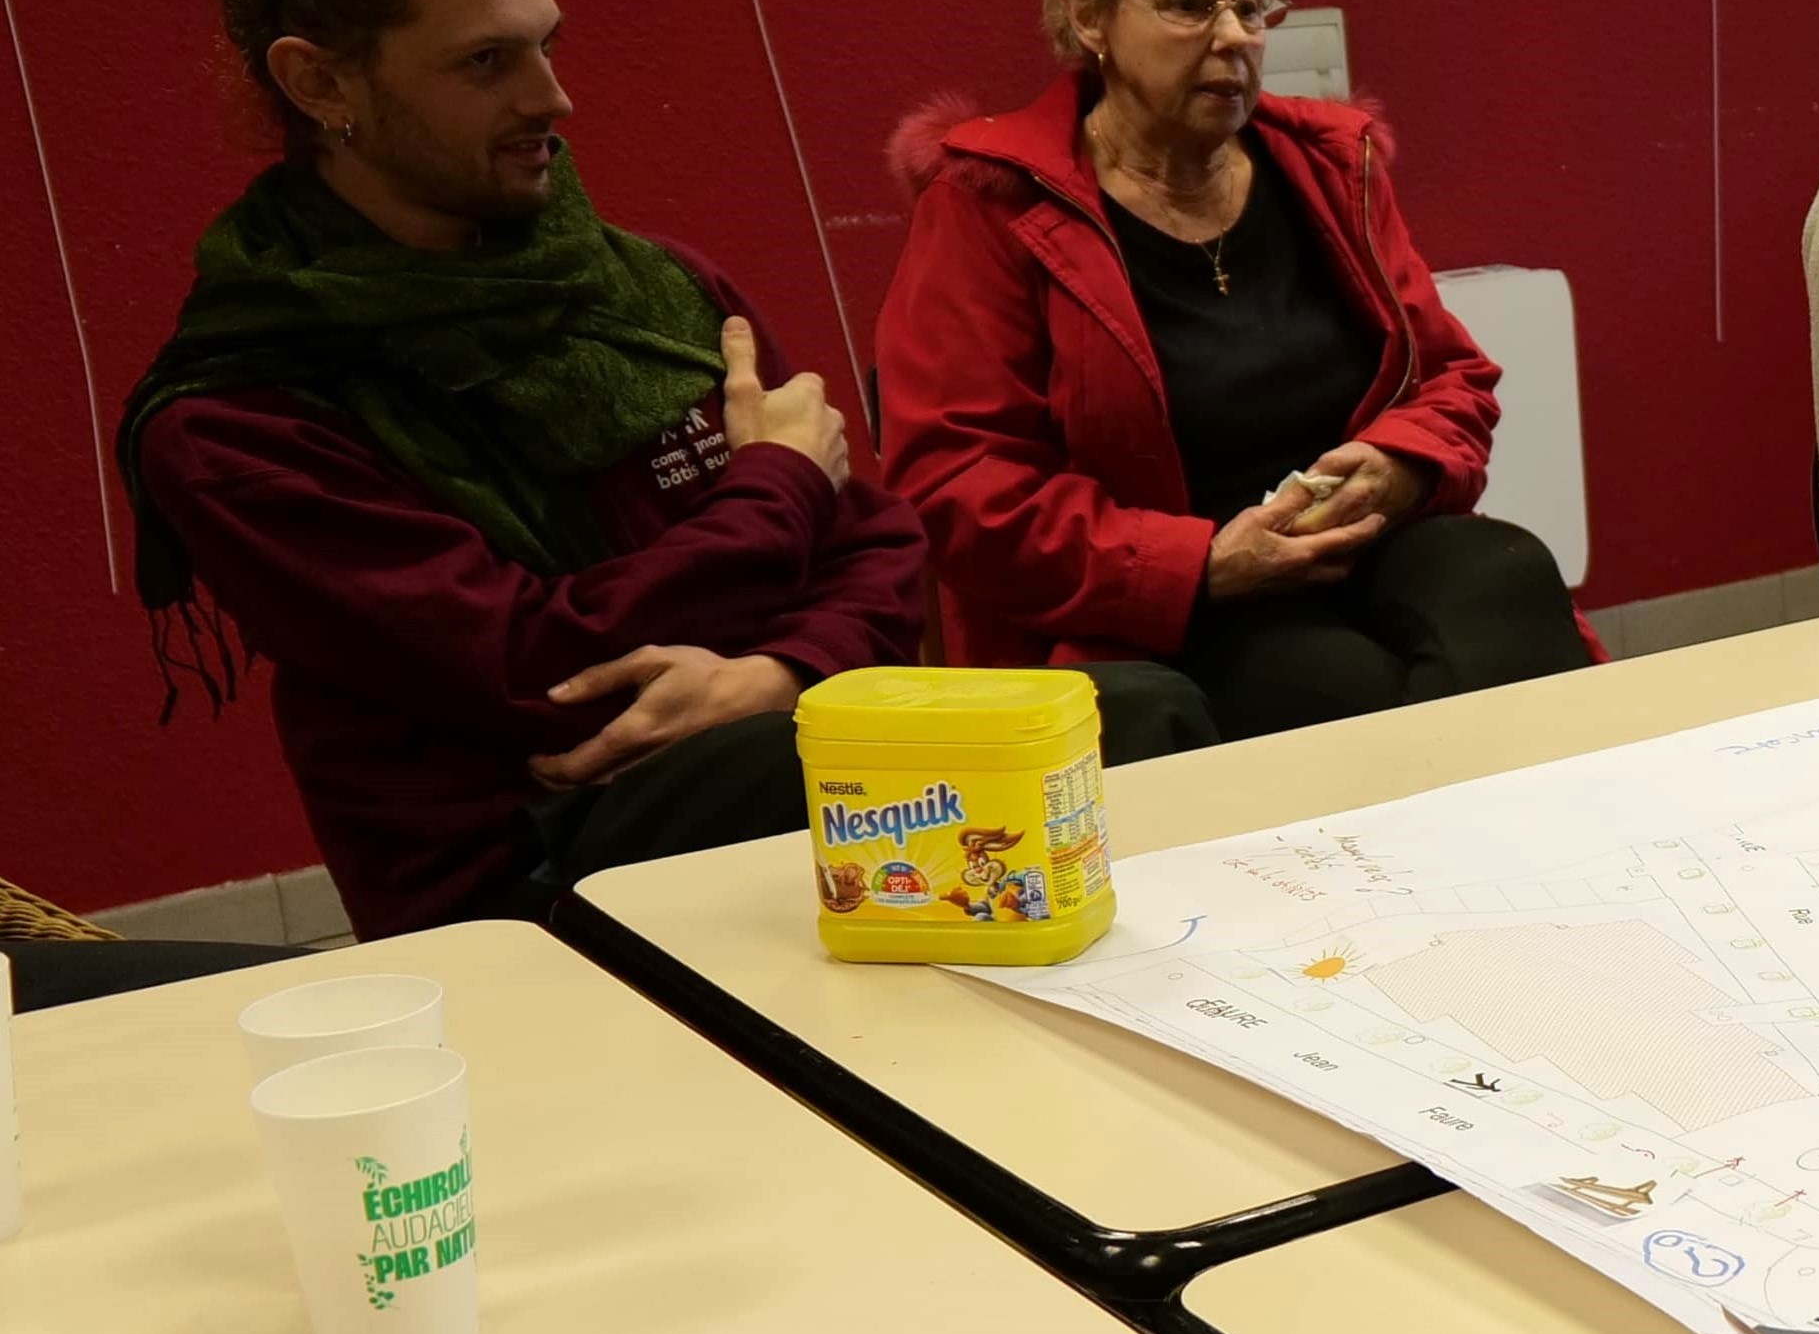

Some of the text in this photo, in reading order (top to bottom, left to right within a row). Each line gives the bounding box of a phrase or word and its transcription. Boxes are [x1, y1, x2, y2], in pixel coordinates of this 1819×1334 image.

[818, 781, 865, 796] Nestlé
[821, 782, 966, 846] Nesquik
[1787, 907, 1814, 926] Rue
[1292, 1050, 1339, 1073] Jean
[1418, 1105, 1476, 1132] Faure
[373, 1246, 431, 1285] PAR
